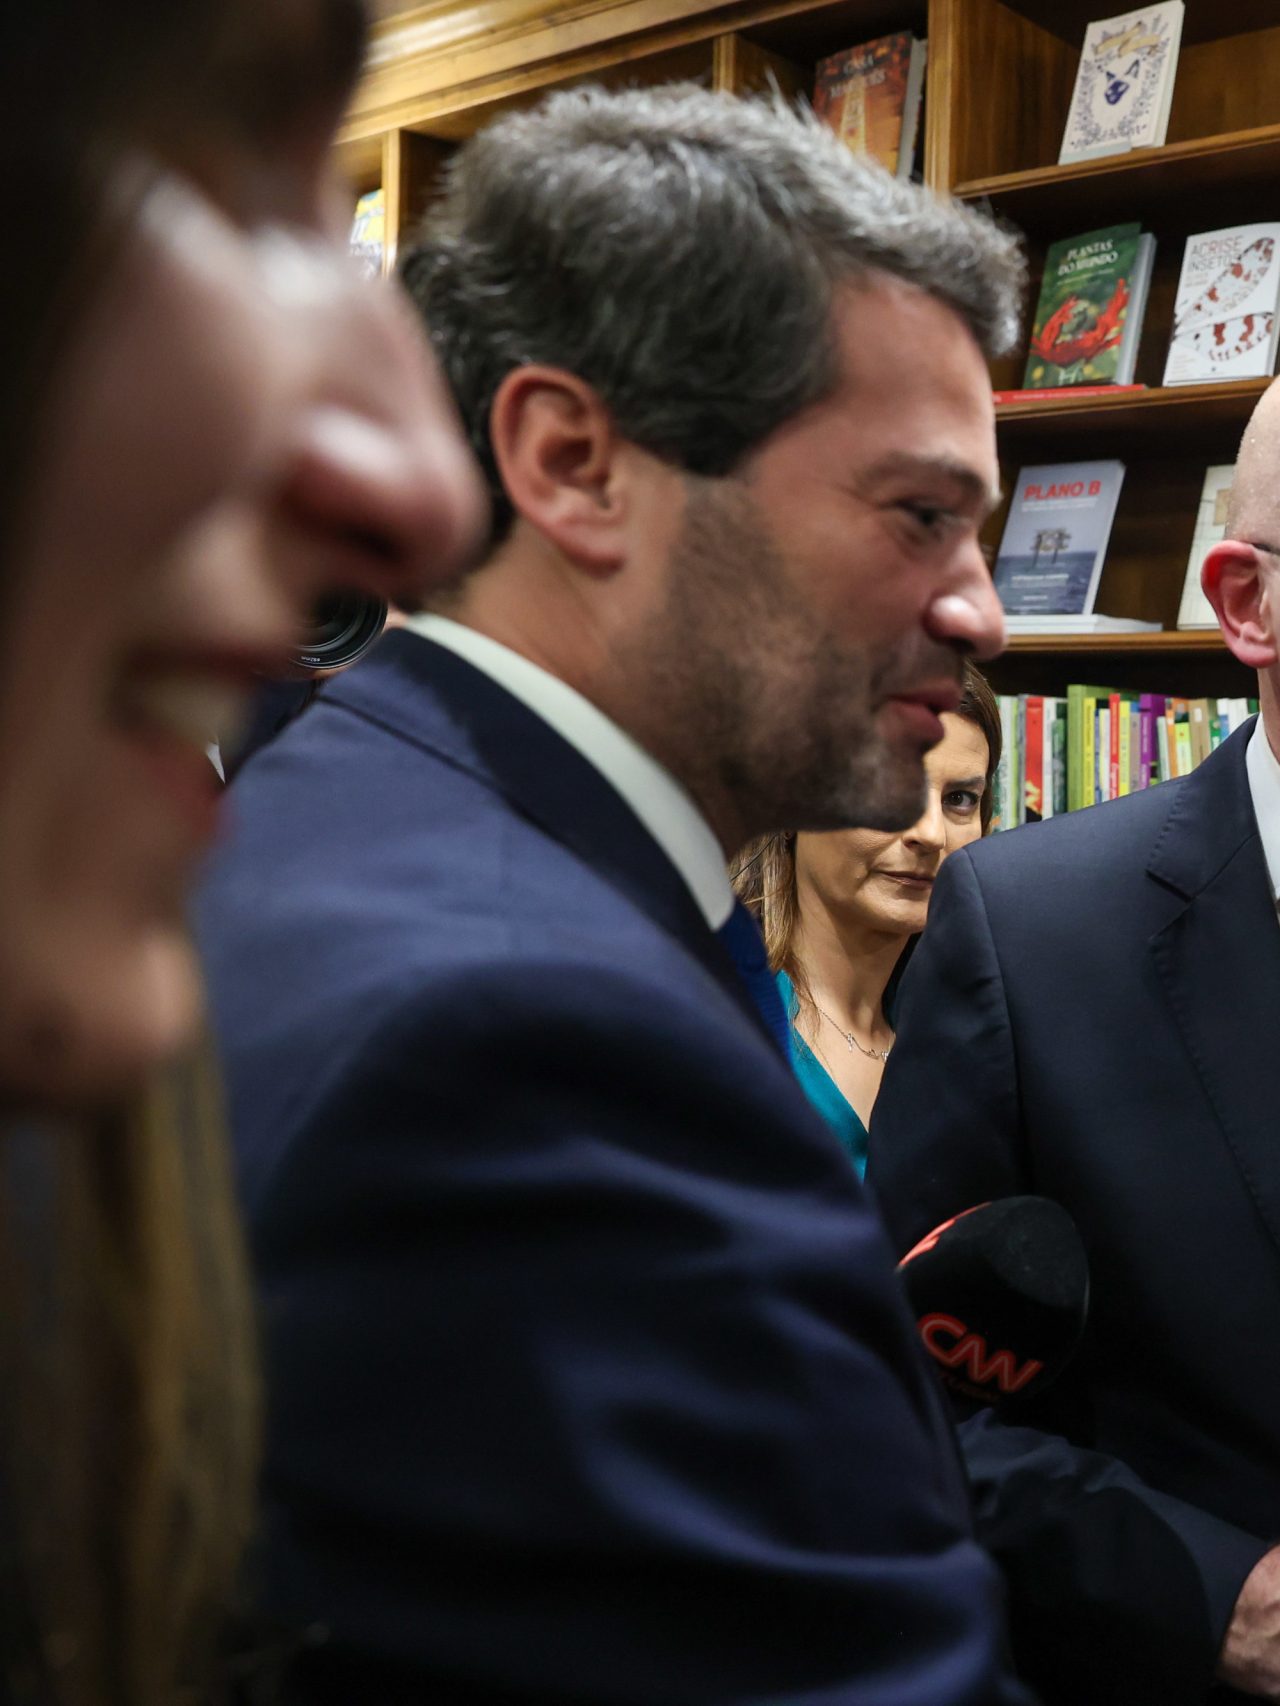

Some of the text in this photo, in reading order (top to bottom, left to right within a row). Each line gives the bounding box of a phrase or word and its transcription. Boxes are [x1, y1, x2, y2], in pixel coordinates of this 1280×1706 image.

[1067, 239, 1113, 260] PLANTAS
[1076, 251, 1118, 272] MUNDO
[1024, 480, 1101, 499] PLANO B
[916, 1312, 1043, 1393] CNN
